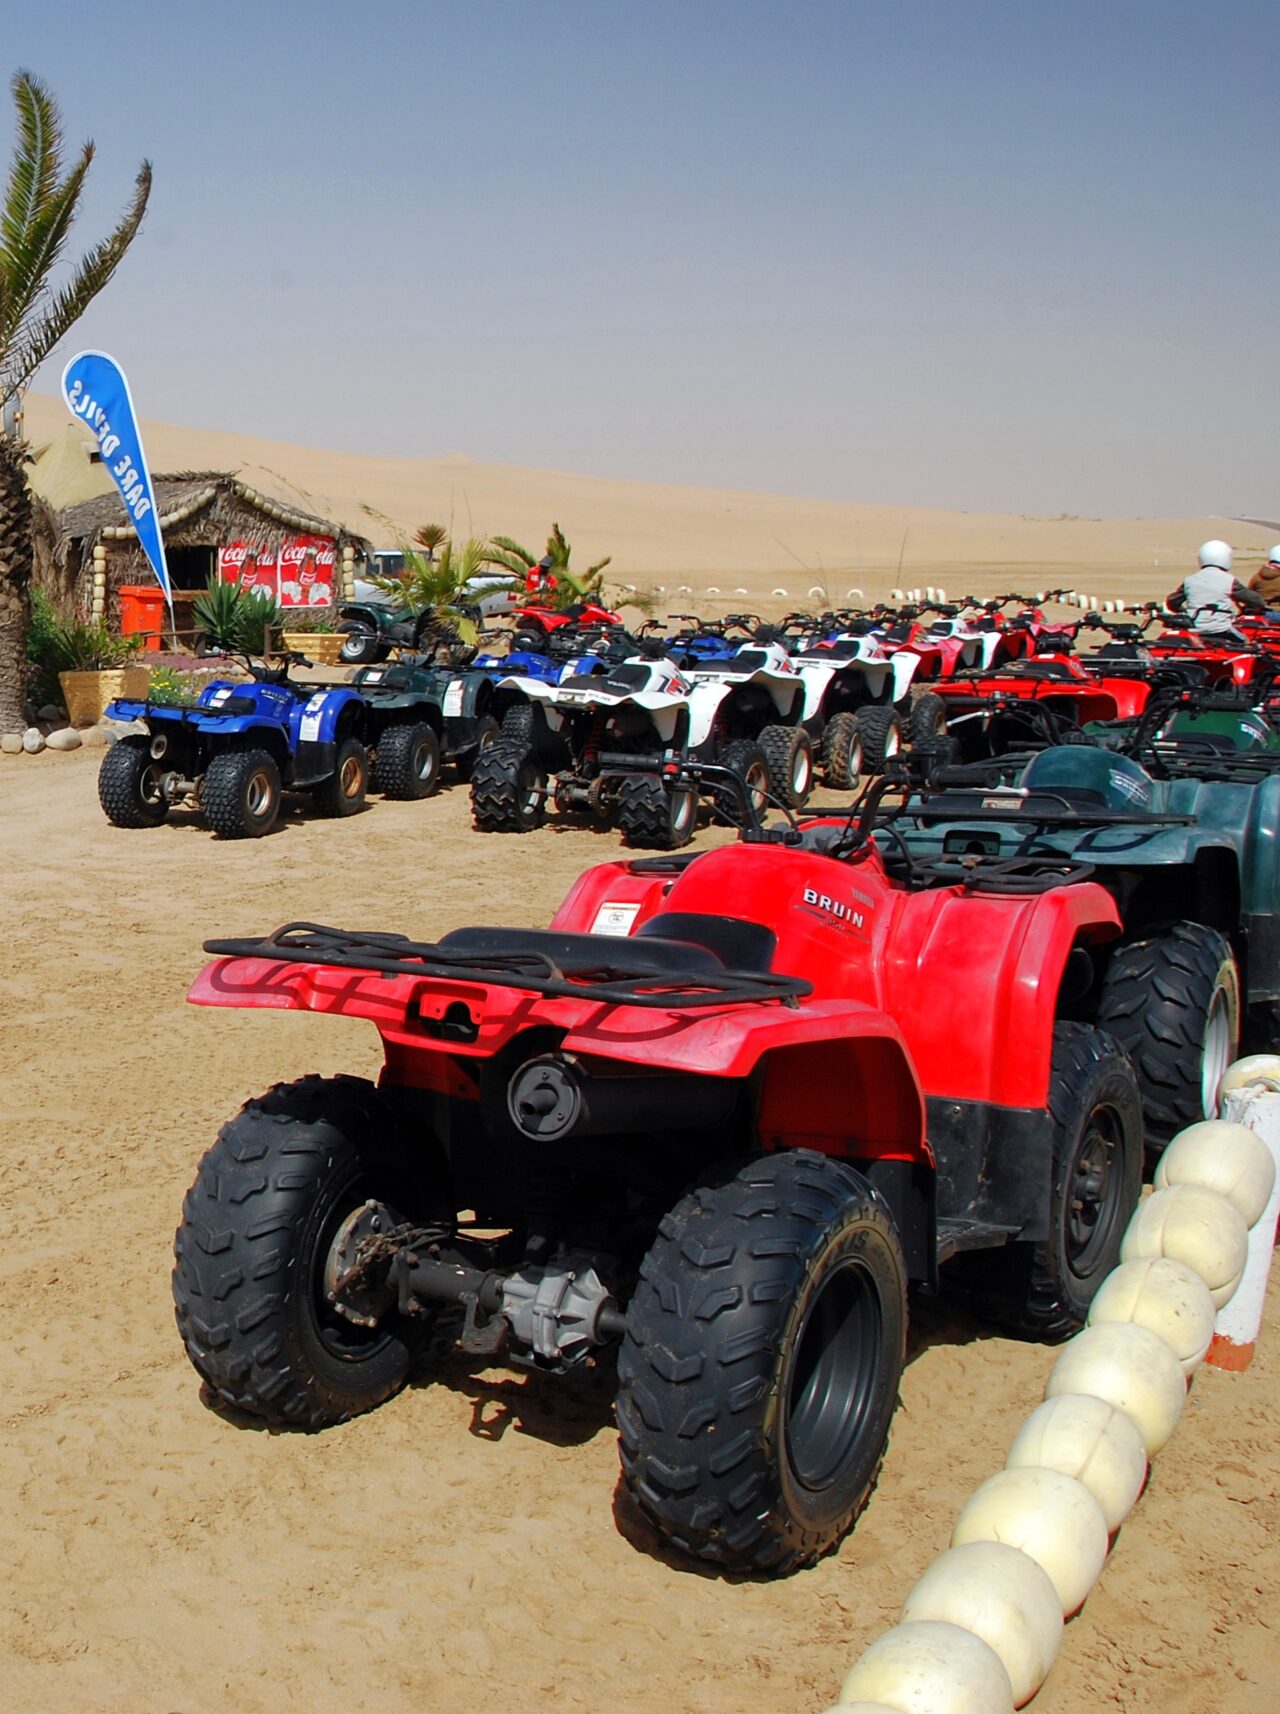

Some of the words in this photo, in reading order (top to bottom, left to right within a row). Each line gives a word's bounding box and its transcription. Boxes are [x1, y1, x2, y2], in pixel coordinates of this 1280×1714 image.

[219, 546, 275, 567] Cocaola
[280, 540, 336, 566] Cocaola
[803, 888, 864, 929] BRUIN
